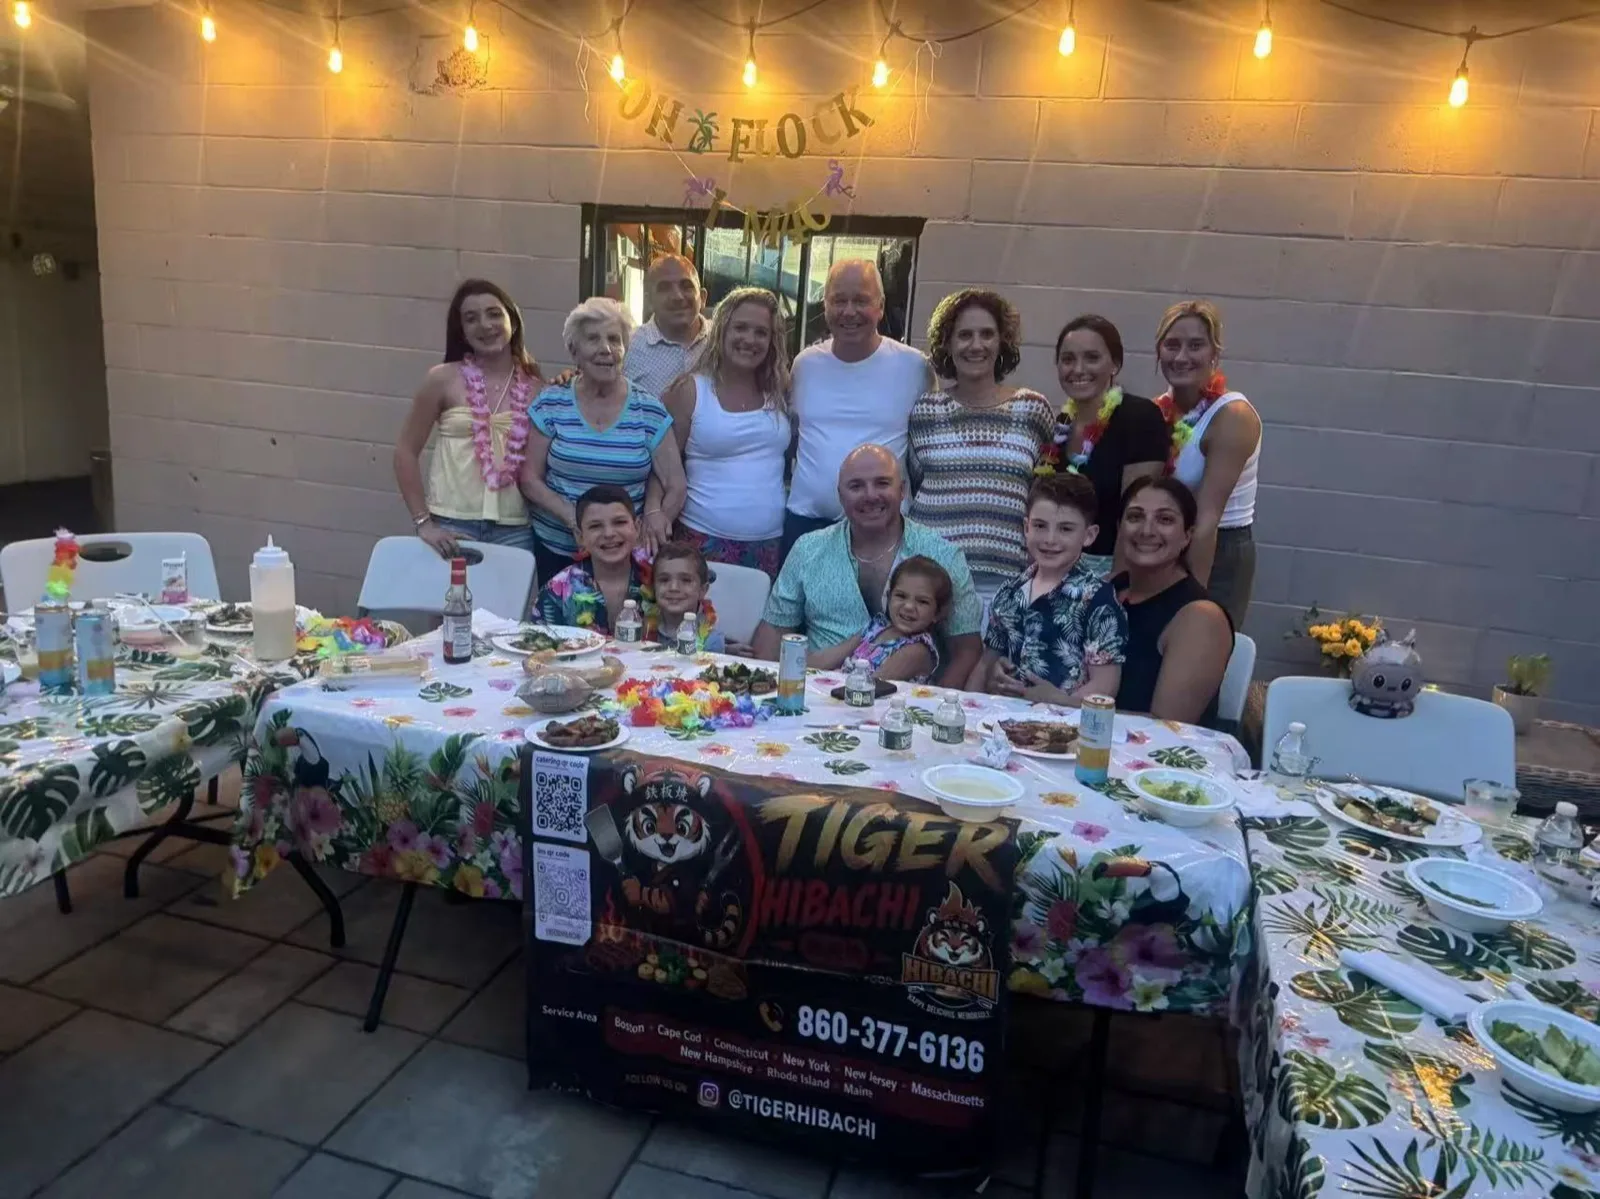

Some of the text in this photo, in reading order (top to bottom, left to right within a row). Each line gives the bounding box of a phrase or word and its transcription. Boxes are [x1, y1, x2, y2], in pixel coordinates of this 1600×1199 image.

[618, 78, 875, 163] OH FLOCK
[535, 756, 561, 768] catering
[569, 759, 584, 769] code
[752, 793, 1010, 893] TIGER
[760, 876, 921, 930] HIBACHI
[907, 957, 998, 1002] HIBACHI
[542, 1005, 598, 1023] Service Area
[798, 1004, 985, 1073] 860-377-6136
[614, 1016, 985, 1107] Boston Cape Cod Connecticut New York New Jersey Massachusetts
[680, 1045, 873, 1098] New Hampshire Rhode Island Maine
[728, 1089, 876, 1139] @TIGERHIBACHI
